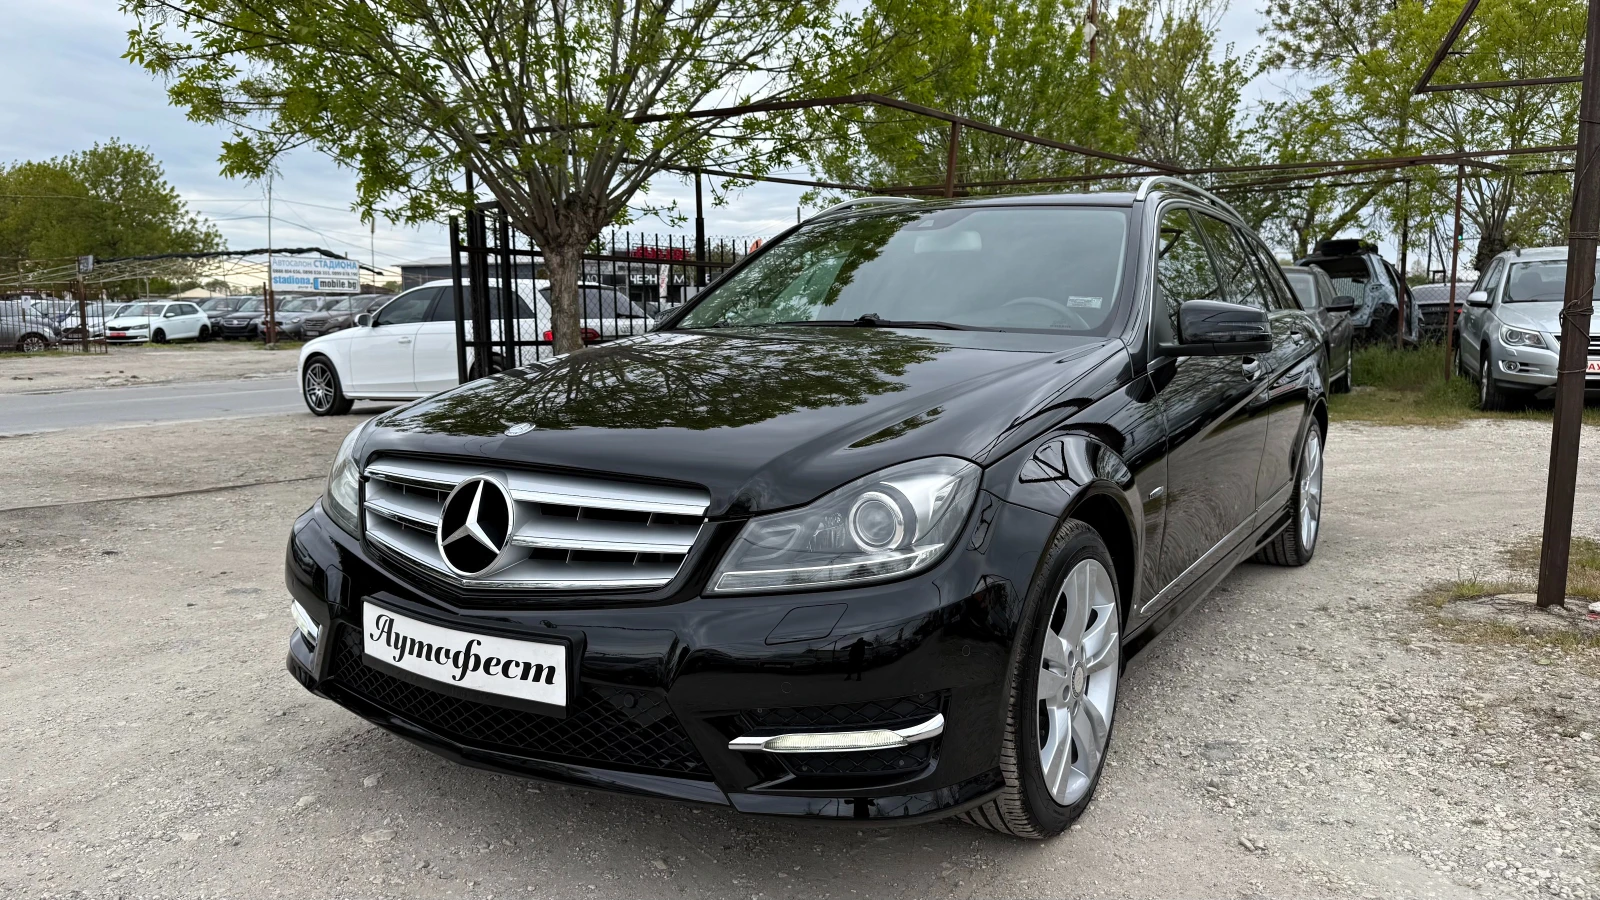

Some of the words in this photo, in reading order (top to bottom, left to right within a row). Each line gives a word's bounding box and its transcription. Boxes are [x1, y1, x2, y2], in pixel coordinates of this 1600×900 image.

[272, 258, 312, 267] Автосалон
[313, 260, 357, 270] СТАДИОНА
[320, 279, 357, 290] mobile.bg
[369, 613, 556, 685] Аутофест
